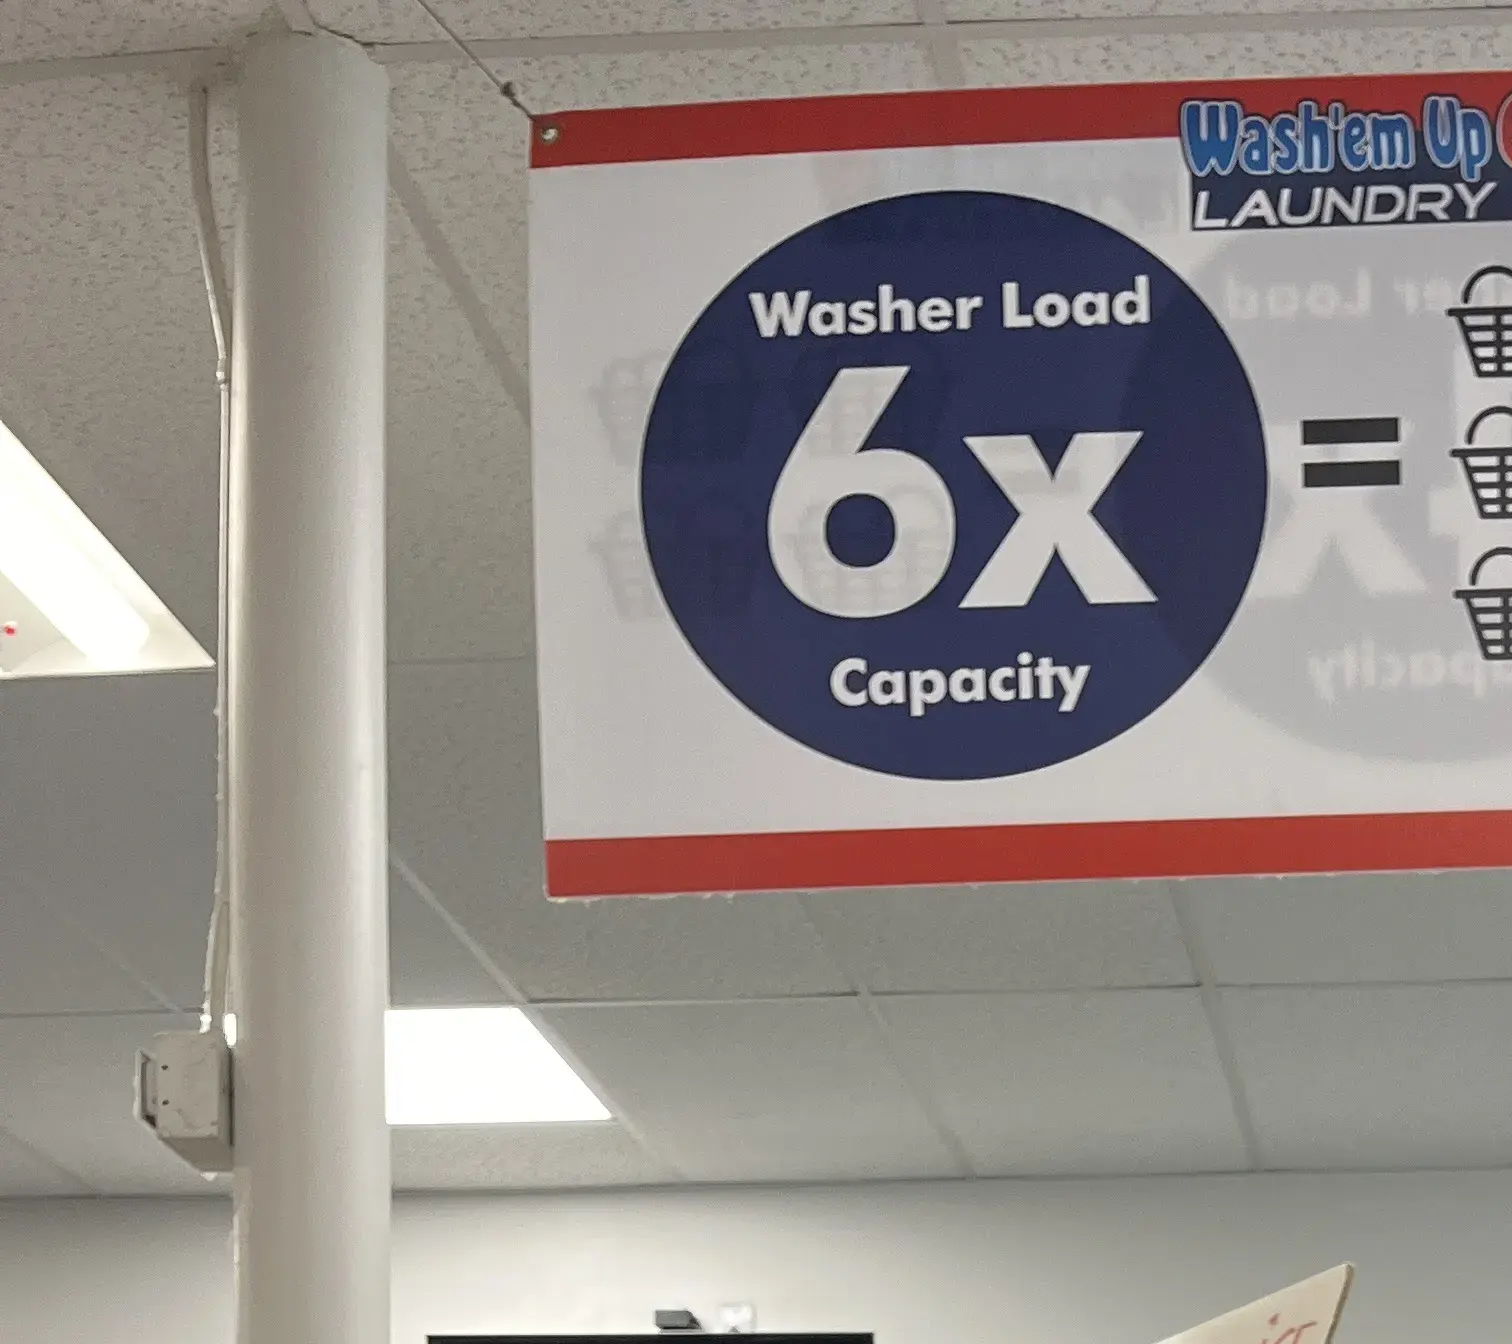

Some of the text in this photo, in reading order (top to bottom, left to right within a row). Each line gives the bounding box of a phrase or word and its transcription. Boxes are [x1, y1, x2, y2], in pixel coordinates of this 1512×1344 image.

[1422, 95, 1492, 182] Up
[1194, 182, 1498, 228] LAUNDRY
[749, 275, 1151, 338] Washer Load
[767, 365, 1158, 618] 6x
[830, 651, 1091, 715] Capacity
